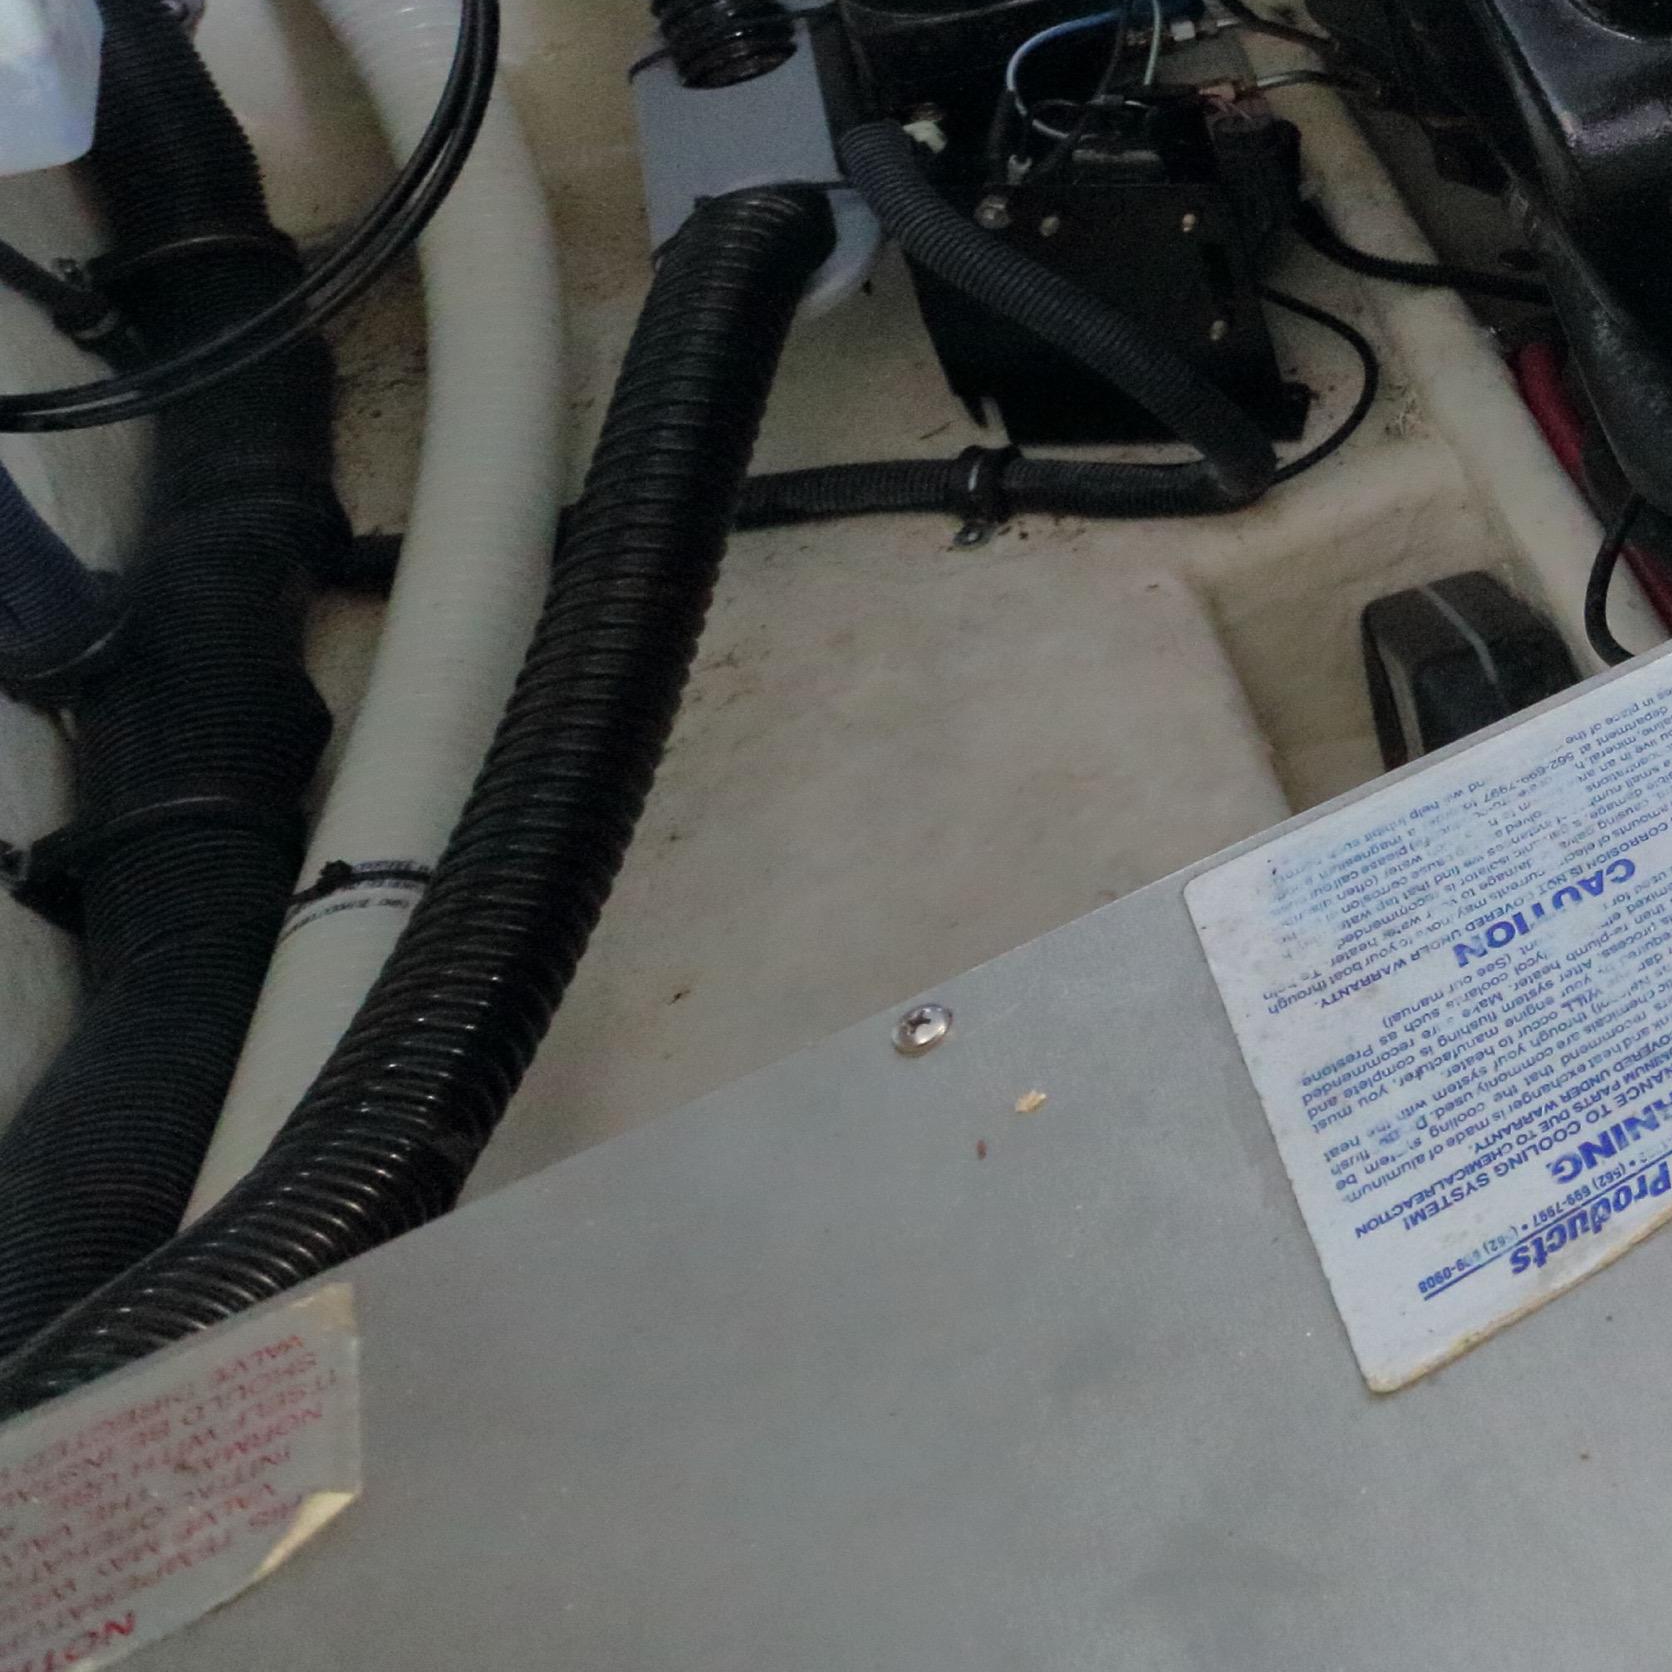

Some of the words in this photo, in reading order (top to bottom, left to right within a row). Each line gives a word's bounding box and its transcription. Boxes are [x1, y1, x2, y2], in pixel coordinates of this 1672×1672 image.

[1565, 730, 1587, 744] the
[1595, 706, 1667, 745] department
[1599, 758, 1615, 772] an
[1619, 750, 1632, 761] in
[1624, 766, 1660, 788] small
[1587, 822, 1668, 868] CORROSION
[1597, 834, 1610, 847] of
[1433, 865, 1460, 885] find
[1569, 864, 1583, 876] IS
[1336, 874, 1378, 900] (often
[1402, 880, 1430, 900] that
[1443, 881, 1456, 893] is
[1460, 887, 1476, 899] to
[1539, 872, 1567, 895] NOT
[1611, 890, 1631, 905] for
[1454, 859, 1634, 966] CAUTION
[1634, 903, 1665, 924] then
[1365, 941, 1397, 965] your
[1476, 953, 1511, 977] (See
[1328, 961, 1363, 984] boat
[1559, 958, 1592, 982] After
[1320, 958, 1406, 1007] WARRANTY.
[1561, 973, 1591, 997] your
[1267, 980, 1327, 1014] through
[1501, 979, 1553, 1013] system
[1382, 991, 1444, 1028] manual)
[1403, 1007, 1440, 1032] such
[1504, 996, 1554, 1027] engine
[1437, 1011, 1497, 1047] flushing
[1518, 1010, 1557, 1038] occur
[1529, 1012, 1587, 1047] through
[1378, 1029, 1397, 1045] as
[1497, 1033, 1513, 1048] to
[1556, 1030, 1579, 1049] are
[1560, 1011, 1646, 1066] recommend
[1621, 1026, 1648, 1049] and
[1419, 1044, 1433, 1057] is
[1587, 1043, 1621, 1068] heat
[1302, 1039, 1414, 1105] recommended
[1343, 1055, 1414, 1097] complete
[1477, 1046, 1553, 1091] commonly
[1523, 1064, 1554, 1086] that
[1357, 1084, 1388, 1107] you
[1432, 1066, 1487, 1101] system
[1493, 1083, 1518, 1102] the
[1559, 1069, 1610, 1102] UNDER
[1306, 1095, 1337, 1120] and
[1430, 1091, 1473, 1119] used.
[1572, 1080, 1620, 1112] PARTS
[1311, 1105, 1352, 1133] must
[1428, 1102, 1484, 1138] cooling
[1491, 1108, 1505, 1122] is
[1538, 1109, 1570, 1132] DUE
[1585, 1103, 1611, 1123] TO
[1445, 1118, 1489, 1146] made
[1474, 1100, 1557, 1152] WARRANTY.
[1515, 1128, 1536, 1145] TO
[1323, 1135, 1360, 1162] heat
[1427, 1143, 1443, 1160] of
[1494, 1120, 1580, 1176] COOLING
[1335, 1173, 1357, 1191] be
[1403, 1172, 1489, 1229] SYSTEM!
[1511, 1162, 1670, 1272] Products
